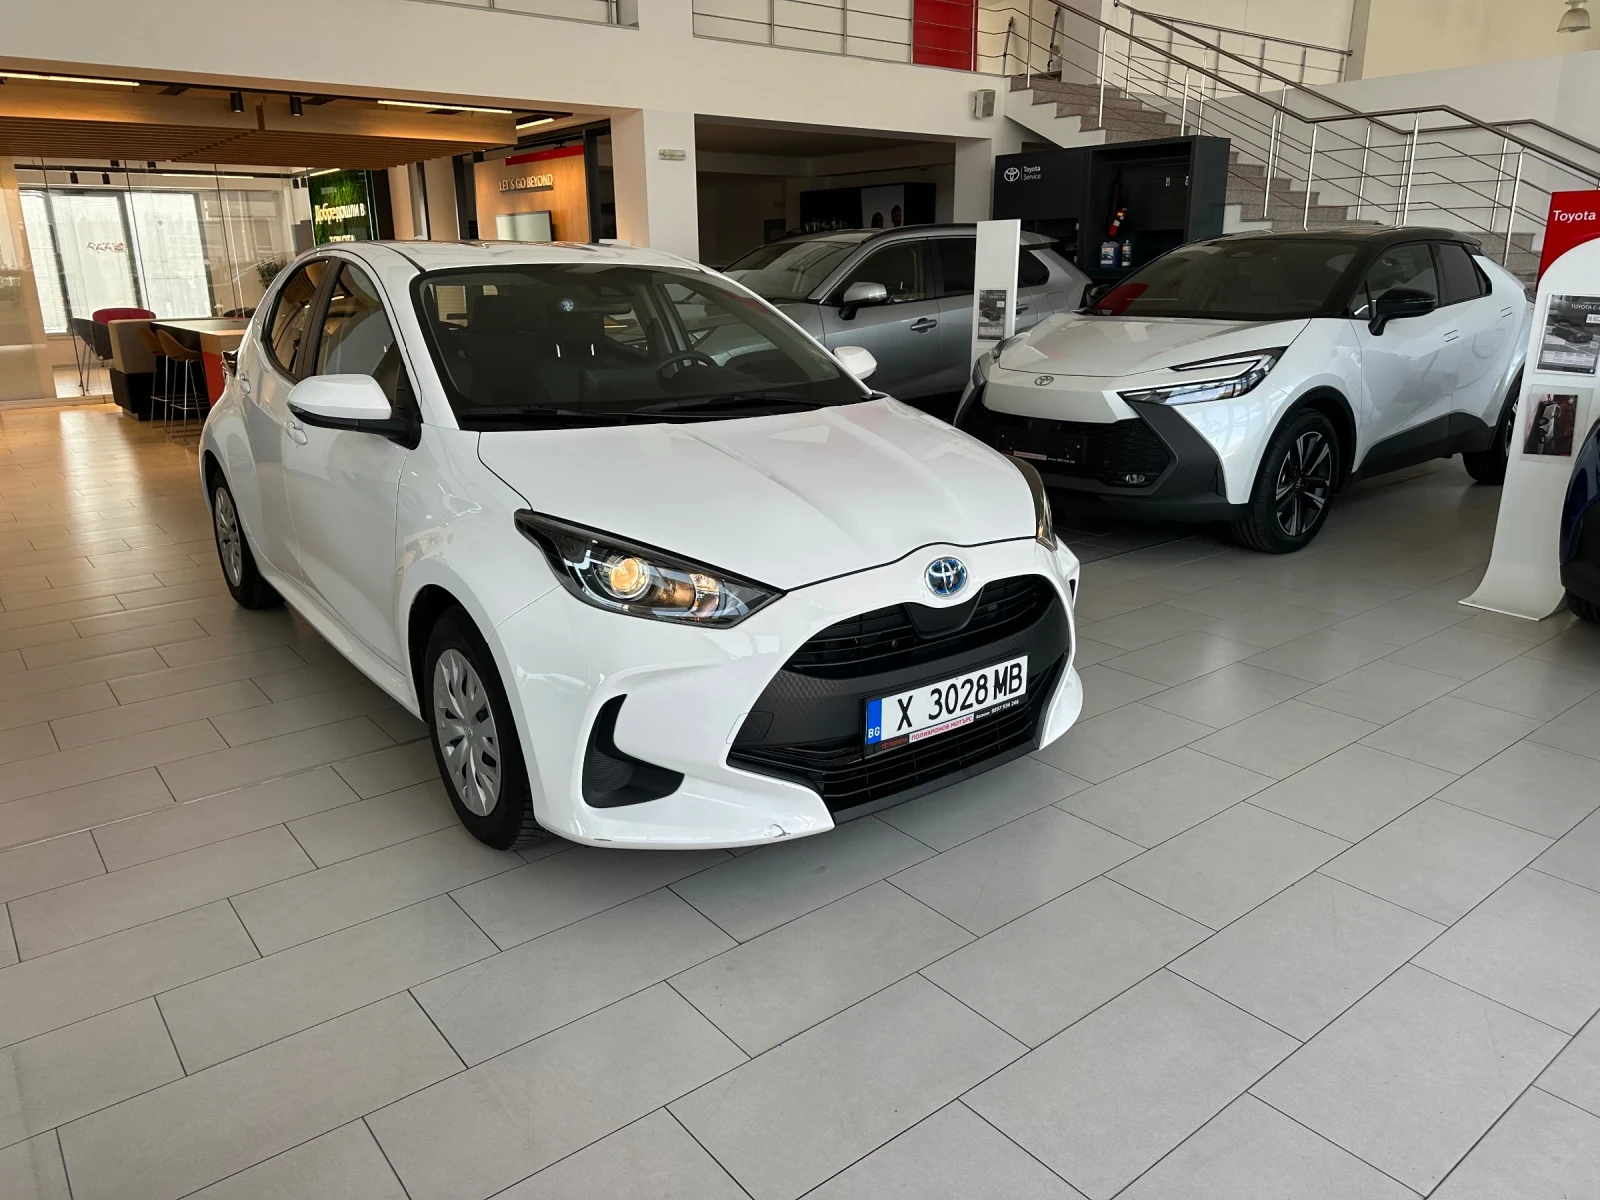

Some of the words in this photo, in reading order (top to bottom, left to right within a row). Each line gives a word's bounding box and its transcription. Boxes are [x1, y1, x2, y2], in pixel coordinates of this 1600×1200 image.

[499, 178, 515, 191] LET'S
[515, 177, 526, 189] GO
[526, 173, 553, 188] BEYOND
[1553, 209, 1596, 224] Toyota
[928, 673, 989, 721] 3028
[993, 662, 1023, 700] MB
[868, 726, 881, 739] BG
[911, 723, 950, 741] ПОЛИХРОНОВ
[950, 715, 973, 729] МОТЪРС
[889, 737, 908, 747] TOYOTA
